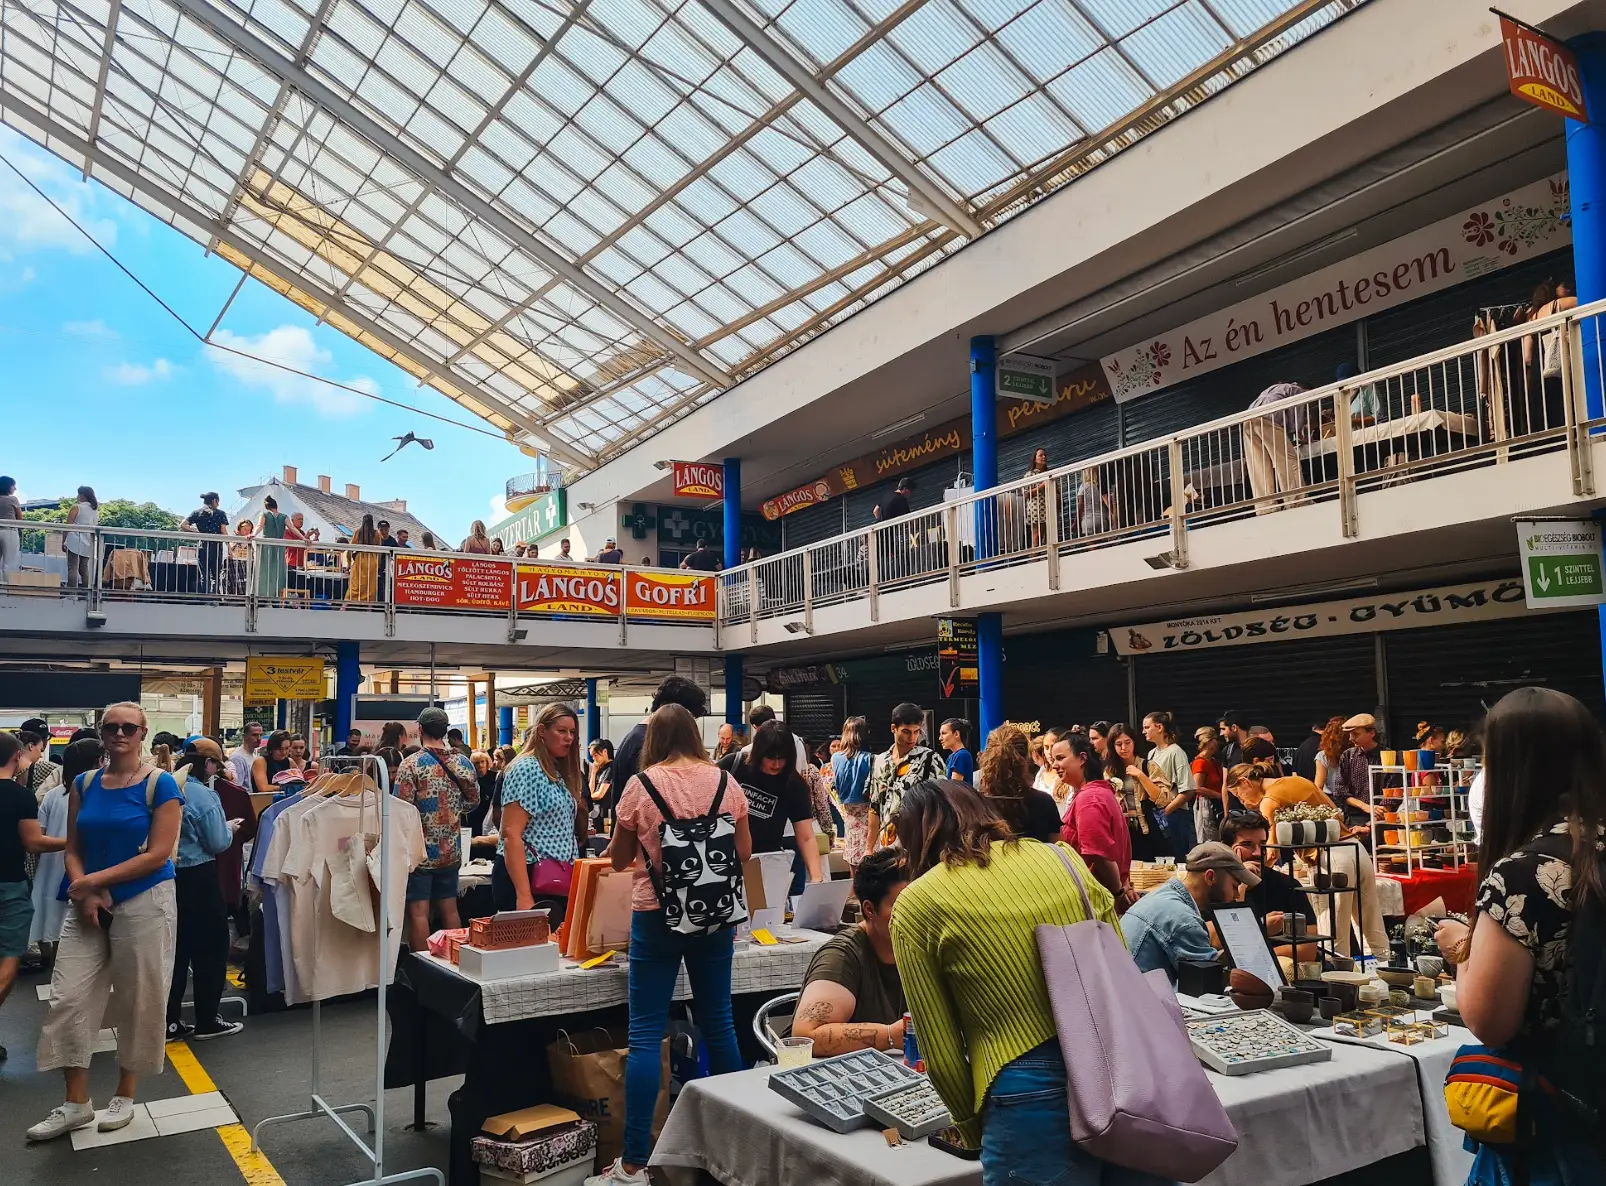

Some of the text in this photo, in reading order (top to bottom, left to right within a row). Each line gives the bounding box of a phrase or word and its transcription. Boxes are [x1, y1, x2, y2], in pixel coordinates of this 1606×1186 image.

[1506, 28, 1582, 105] LÁNGOS
[1531, 86, 1566, 107] LAND
[1182, 335, 1217, 369] Az
[1225, 318, 1263, 352] én
[1269, 247, 1456, 335] hentesem
[1003, 374, 1012, 386] 2
[876, 430, 960, 474] sütemény
[676, 464, 722, 491] LÁNGOS
[778, 488, 814, 512] LÁNGOS
[1534, 532, 1595, 542] BIOEGÉSZSÉG BIOBOLT
[398, 561, 453, 579] LÁNGOS
[1554, 564, 1594, 585] 1 SZINTTEL
[1566, 575, 1592, 584] LEJJEBB
[405, 589, 445, 597] HAMBURGER
[520, 574, 618, 606] LÁNGOS
[635, 581, 706, 605] GOFRI
[546, 603, 593, 611] LAND
[1163, 581, 1526, 649] ZÖLDSÉG GYÜMÖ
[266, 666, 276, 675] 3
